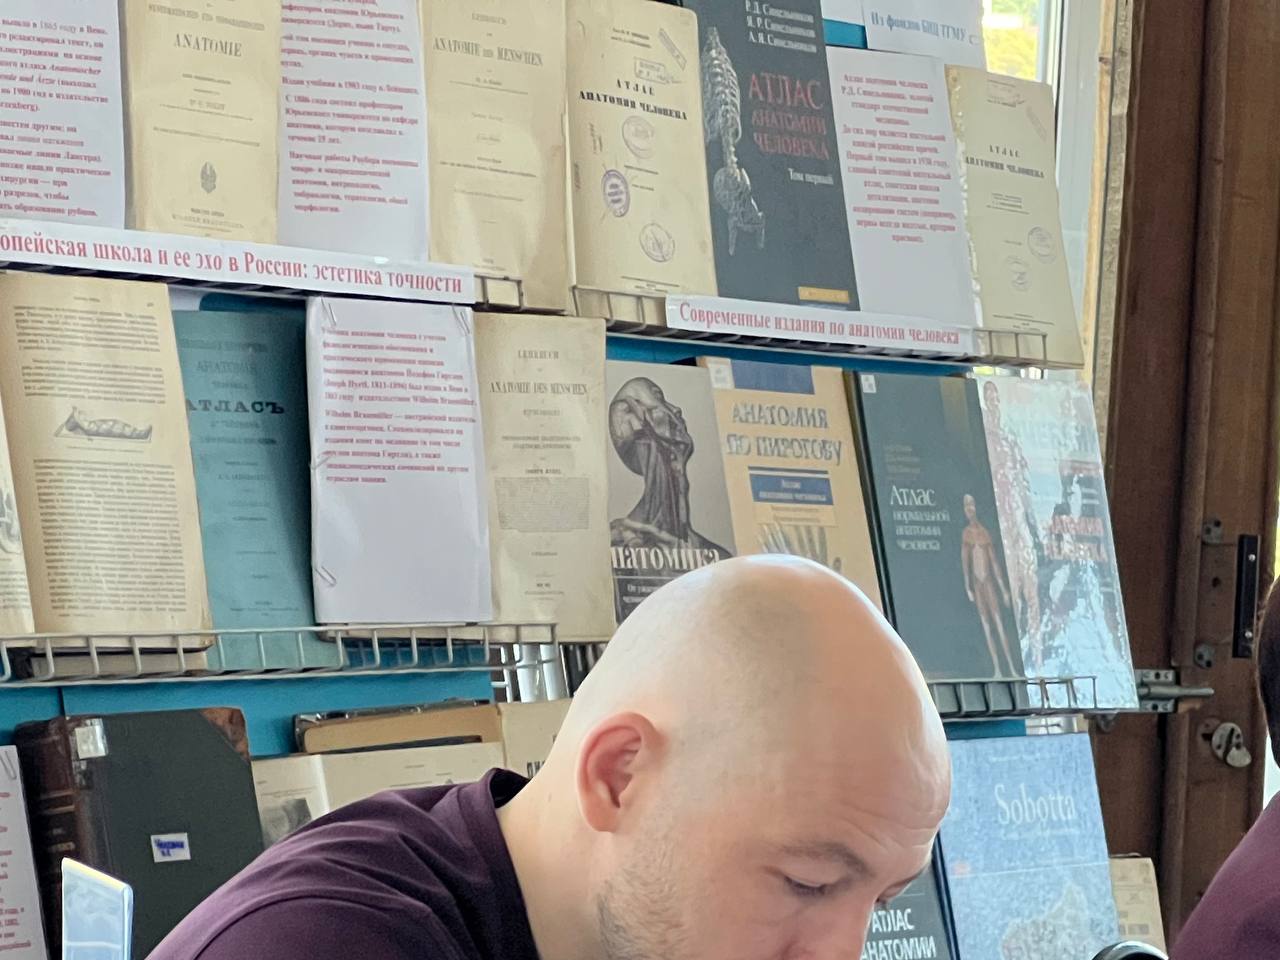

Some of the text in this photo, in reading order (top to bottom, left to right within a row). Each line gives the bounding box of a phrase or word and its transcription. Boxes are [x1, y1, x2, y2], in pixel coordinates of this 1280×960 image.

[174, 33, 243, 57] ANATOMIE
[579, 90, 688, 121] АНАТОМИИ ЧЕЛОВЕКА
[749, 73, 825, 109] АТЛАС
[1, 232, 463, 294] опейская школа и ее эхо в России: эстетика точности
[679, 302, 960, 345] Современные издания по анатомии человека
[187, 399, 285, 414] АТЛАСЪ
[733, 402, 829, 429] АНАТОМИЯ
[756, 435, 842, 466] ПИРОГОВУ
[890, 485, 936, 507] Атлас
[995, 783, 1076, 825] Sobotta
[872, 908, 915, 933] АТЛАС
